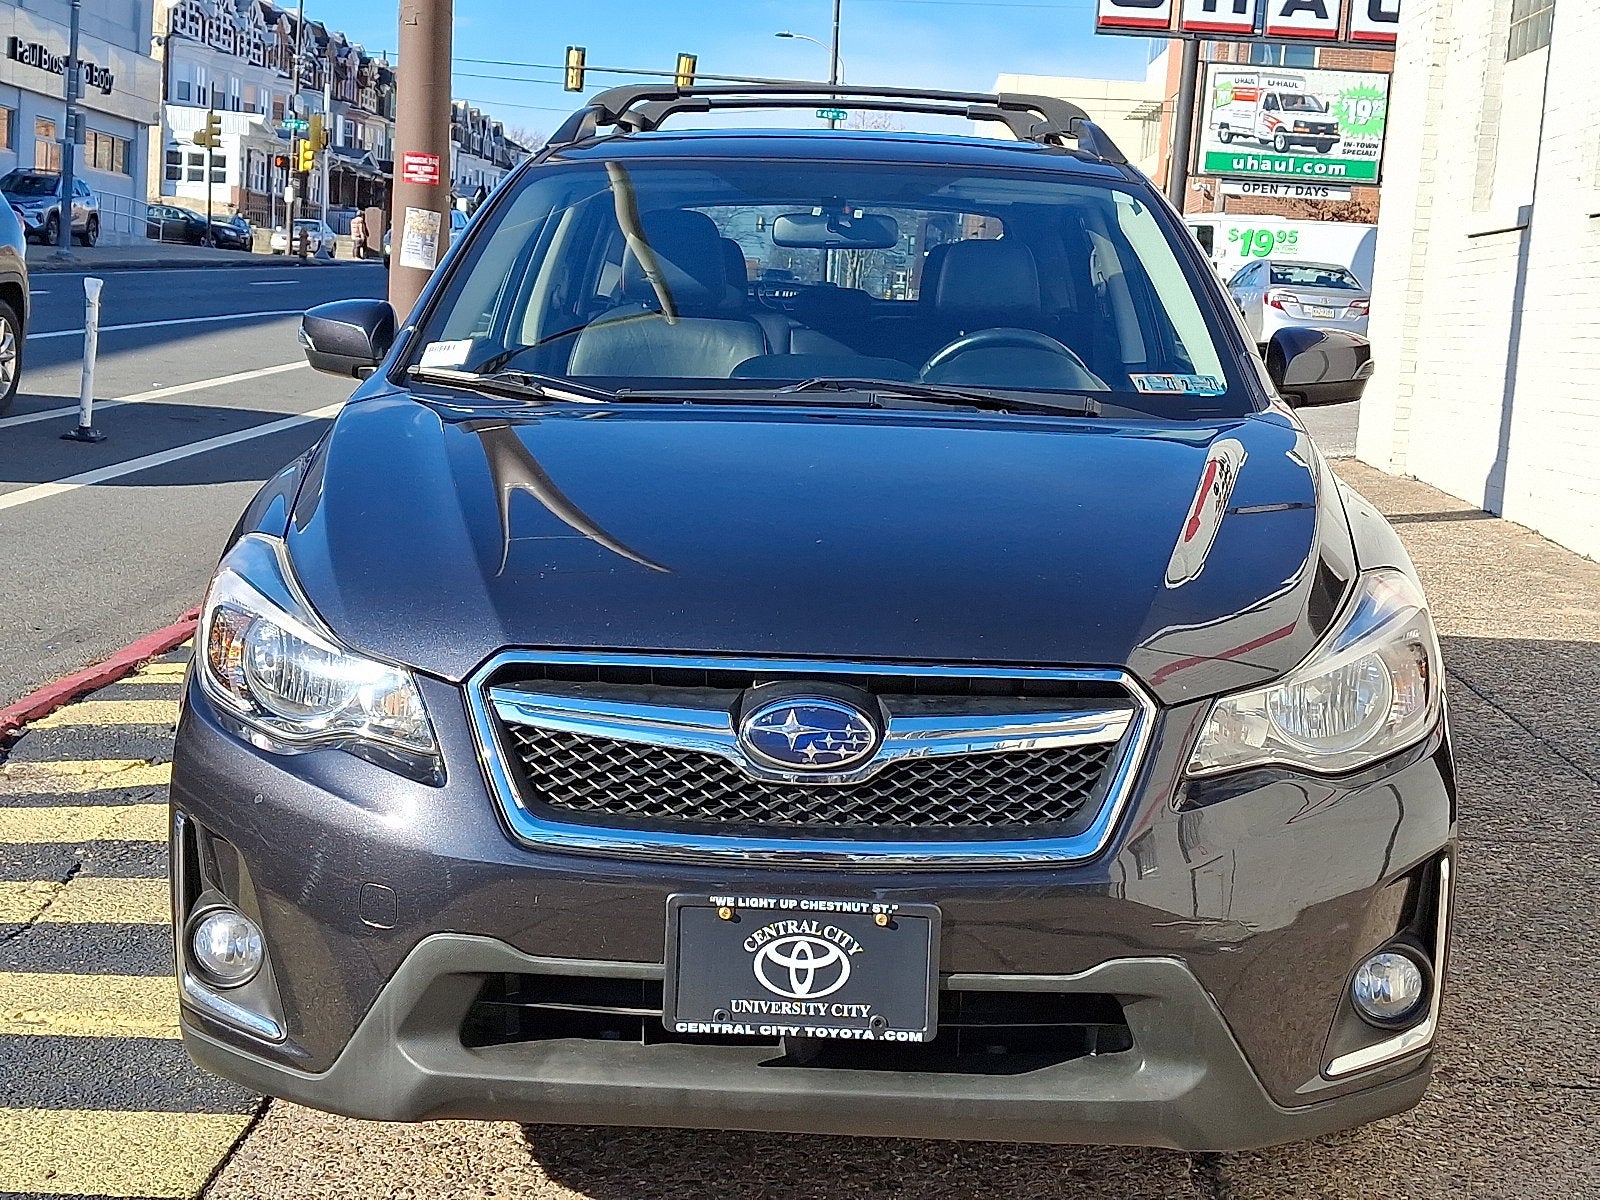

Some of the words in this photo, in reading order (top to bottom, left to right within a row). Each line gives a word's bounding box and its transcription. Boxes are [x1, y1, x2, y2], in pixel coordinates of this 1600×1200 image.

[13, 36, 40, 67] Paul
[1232, 155, 1346, 176] uhaul.com
[1242, 183, 1279, 195] OPEN
[1282, 184, 1291, 195] 7
[1295, 185, 1329, 197] DAYS
[738, 897, 777, 909] LIGHT
[780, 899, 798, 909] UP
[800, 900, 869, 913] CHESTNUT
[743, 919, 822, 953] CENTRAL
[823, 925, 864, 956] CITY
[730, 999, 829, 1017] UNIVERSITY
[831, 1003, 872, 1018] CITY
[675, 1022, 756, 1035] CENTRAL
[759, 1025, 801, 1037] CITY
[804, 1027, 875, 1040] TOYOTA
[879, 1030, 923, 1042] .COM
